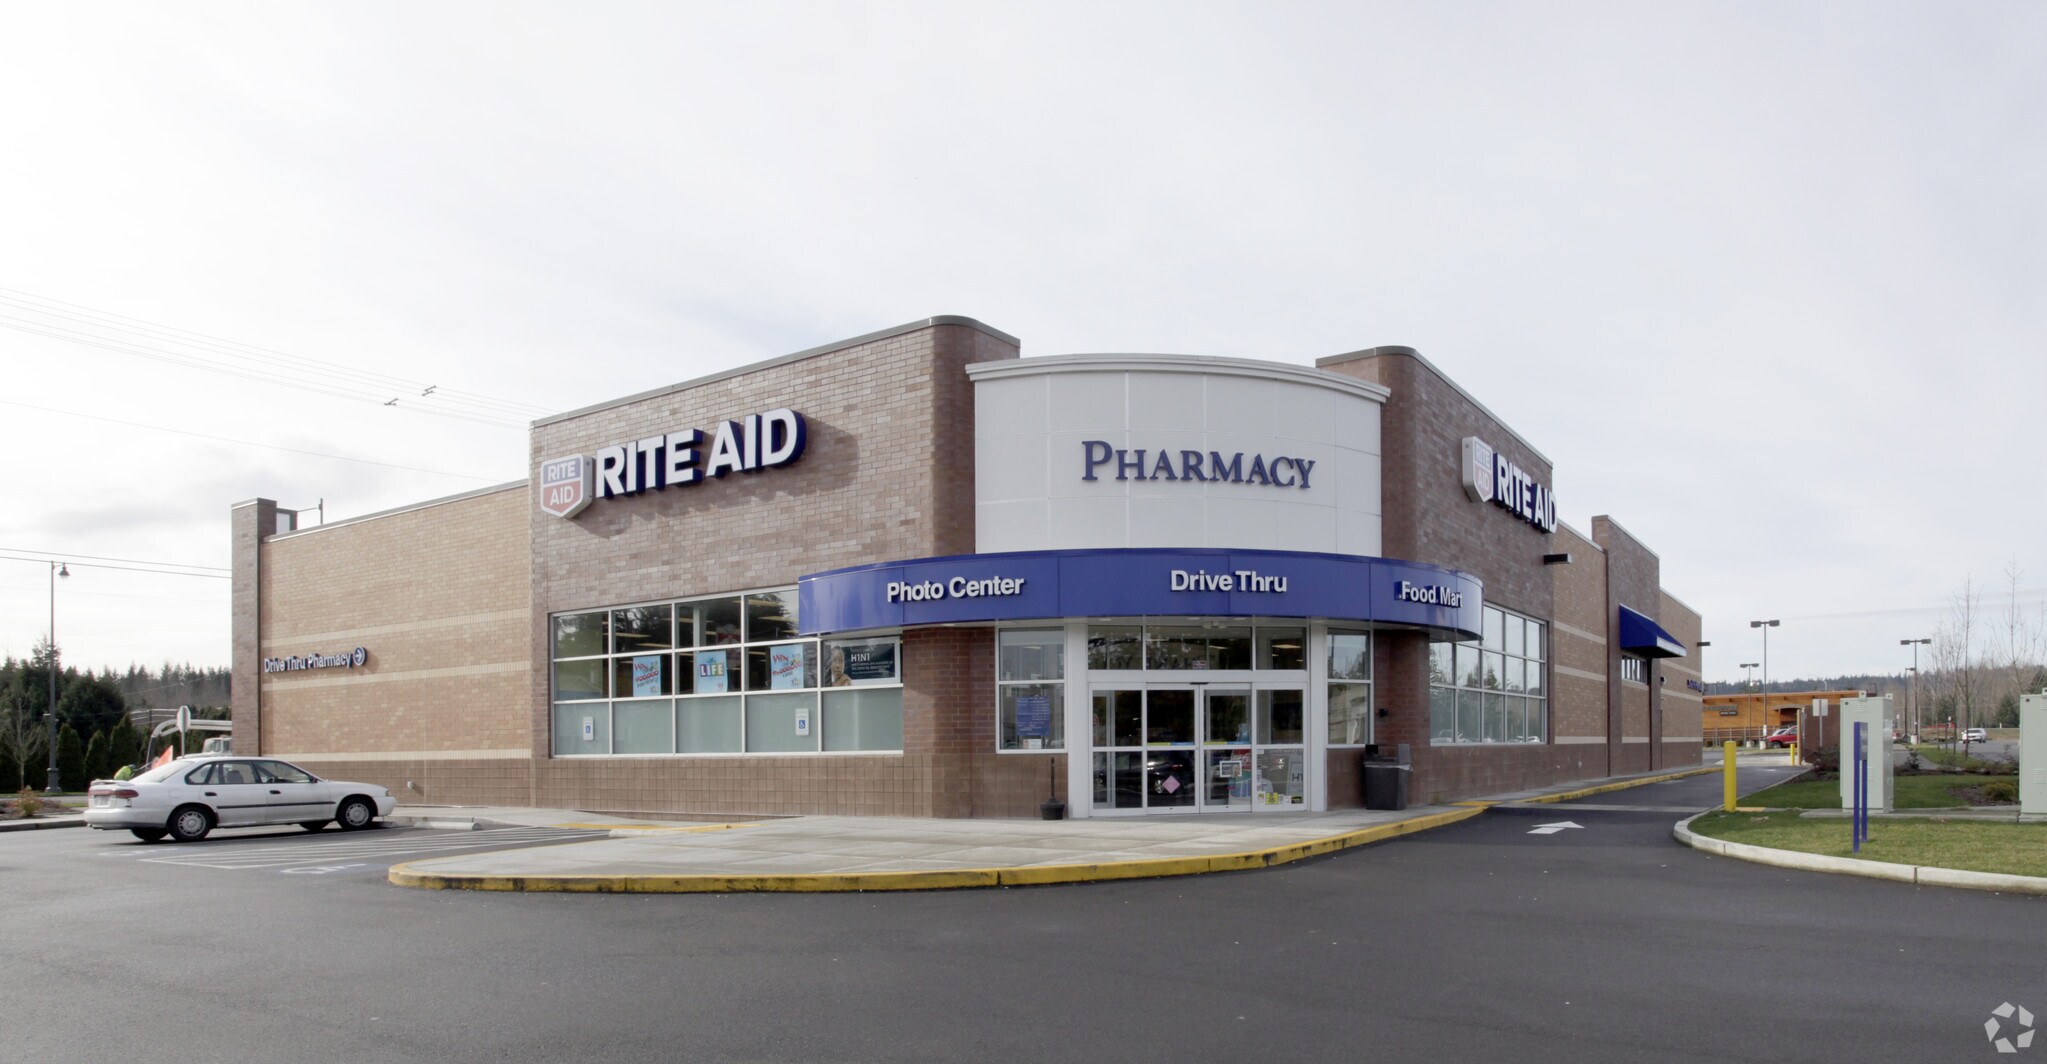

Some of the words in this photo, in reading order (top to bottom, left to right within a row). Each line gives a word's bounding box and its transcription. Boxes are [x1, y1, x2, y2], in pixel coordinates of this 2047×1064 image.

[595, 428, 696, 499] RITE
[705, 407, 800, 478] AID
[1081, 440, 1316, 489] PHARMACY
[547, 459, 577, 482] RITE
[549, 485, 574, 507] AID
[1496, 452, 1532, 520] RITE
[1534, 482, 1558, 534] AID
[887, 580, 945, 603] Photo
[949, 575, 1025, 598] Center
[1171, 570, 1233, 591] Drive
[1235, 570, 1287, 592] Thru
[1401, 580, 1437, 604] Food
[1440, 585, 1463, 608] Mart
[264, 657, 285, 673] Drive
[286, 656, 306, 671] Thru
[308, 653, 352, 669] Pharmacy
[850, 652, 870, 662] H1N1
[700, 663, 724, 677] LIFE
